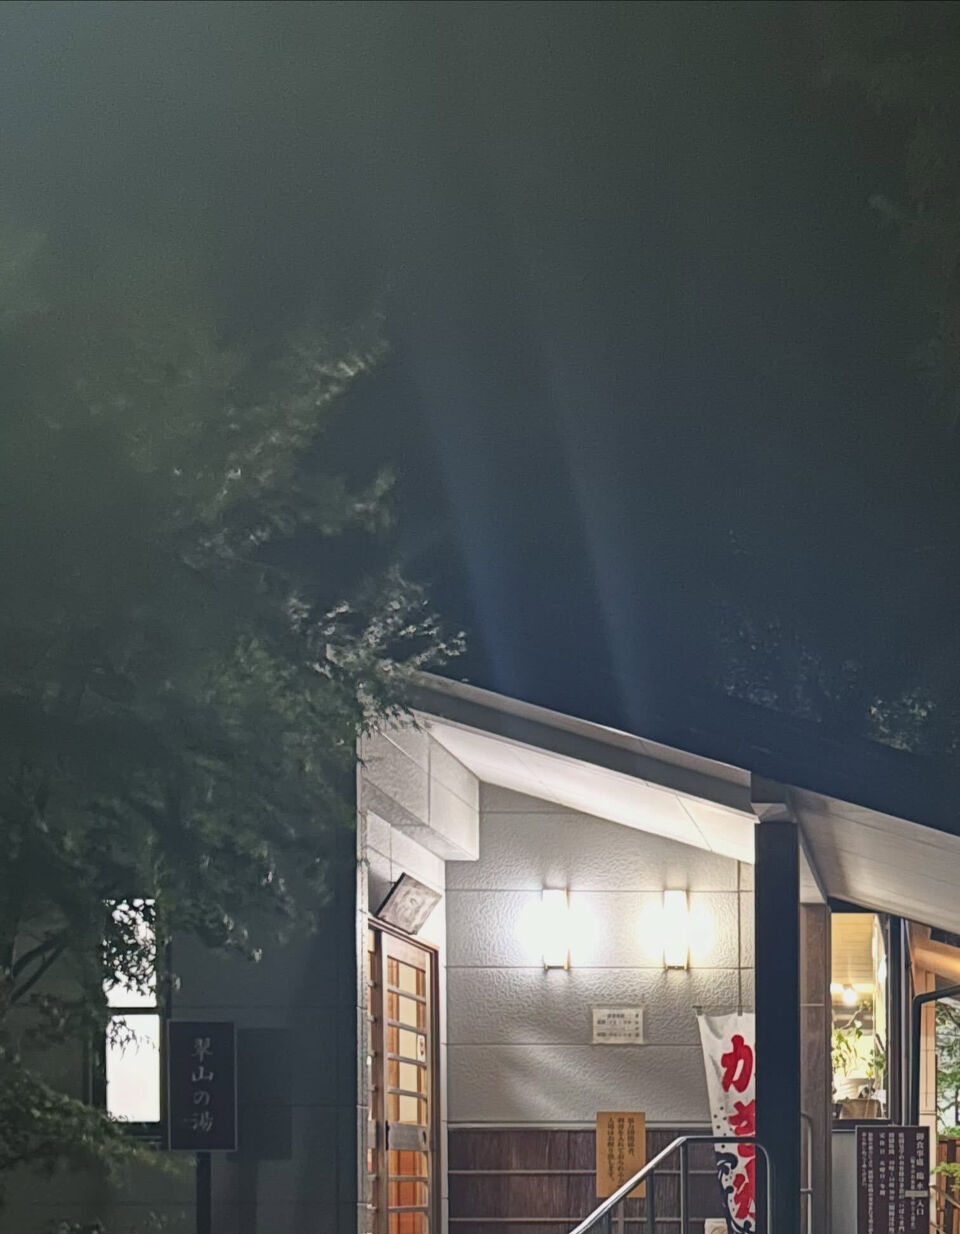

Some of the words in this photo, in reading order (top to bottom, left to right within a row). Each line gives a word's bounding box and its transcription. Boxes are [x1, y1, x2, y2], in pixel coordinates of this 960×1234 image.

[191, 1037, 214, 1132] 翠山の湯
[916, 1199, 925, 1216] 入口
